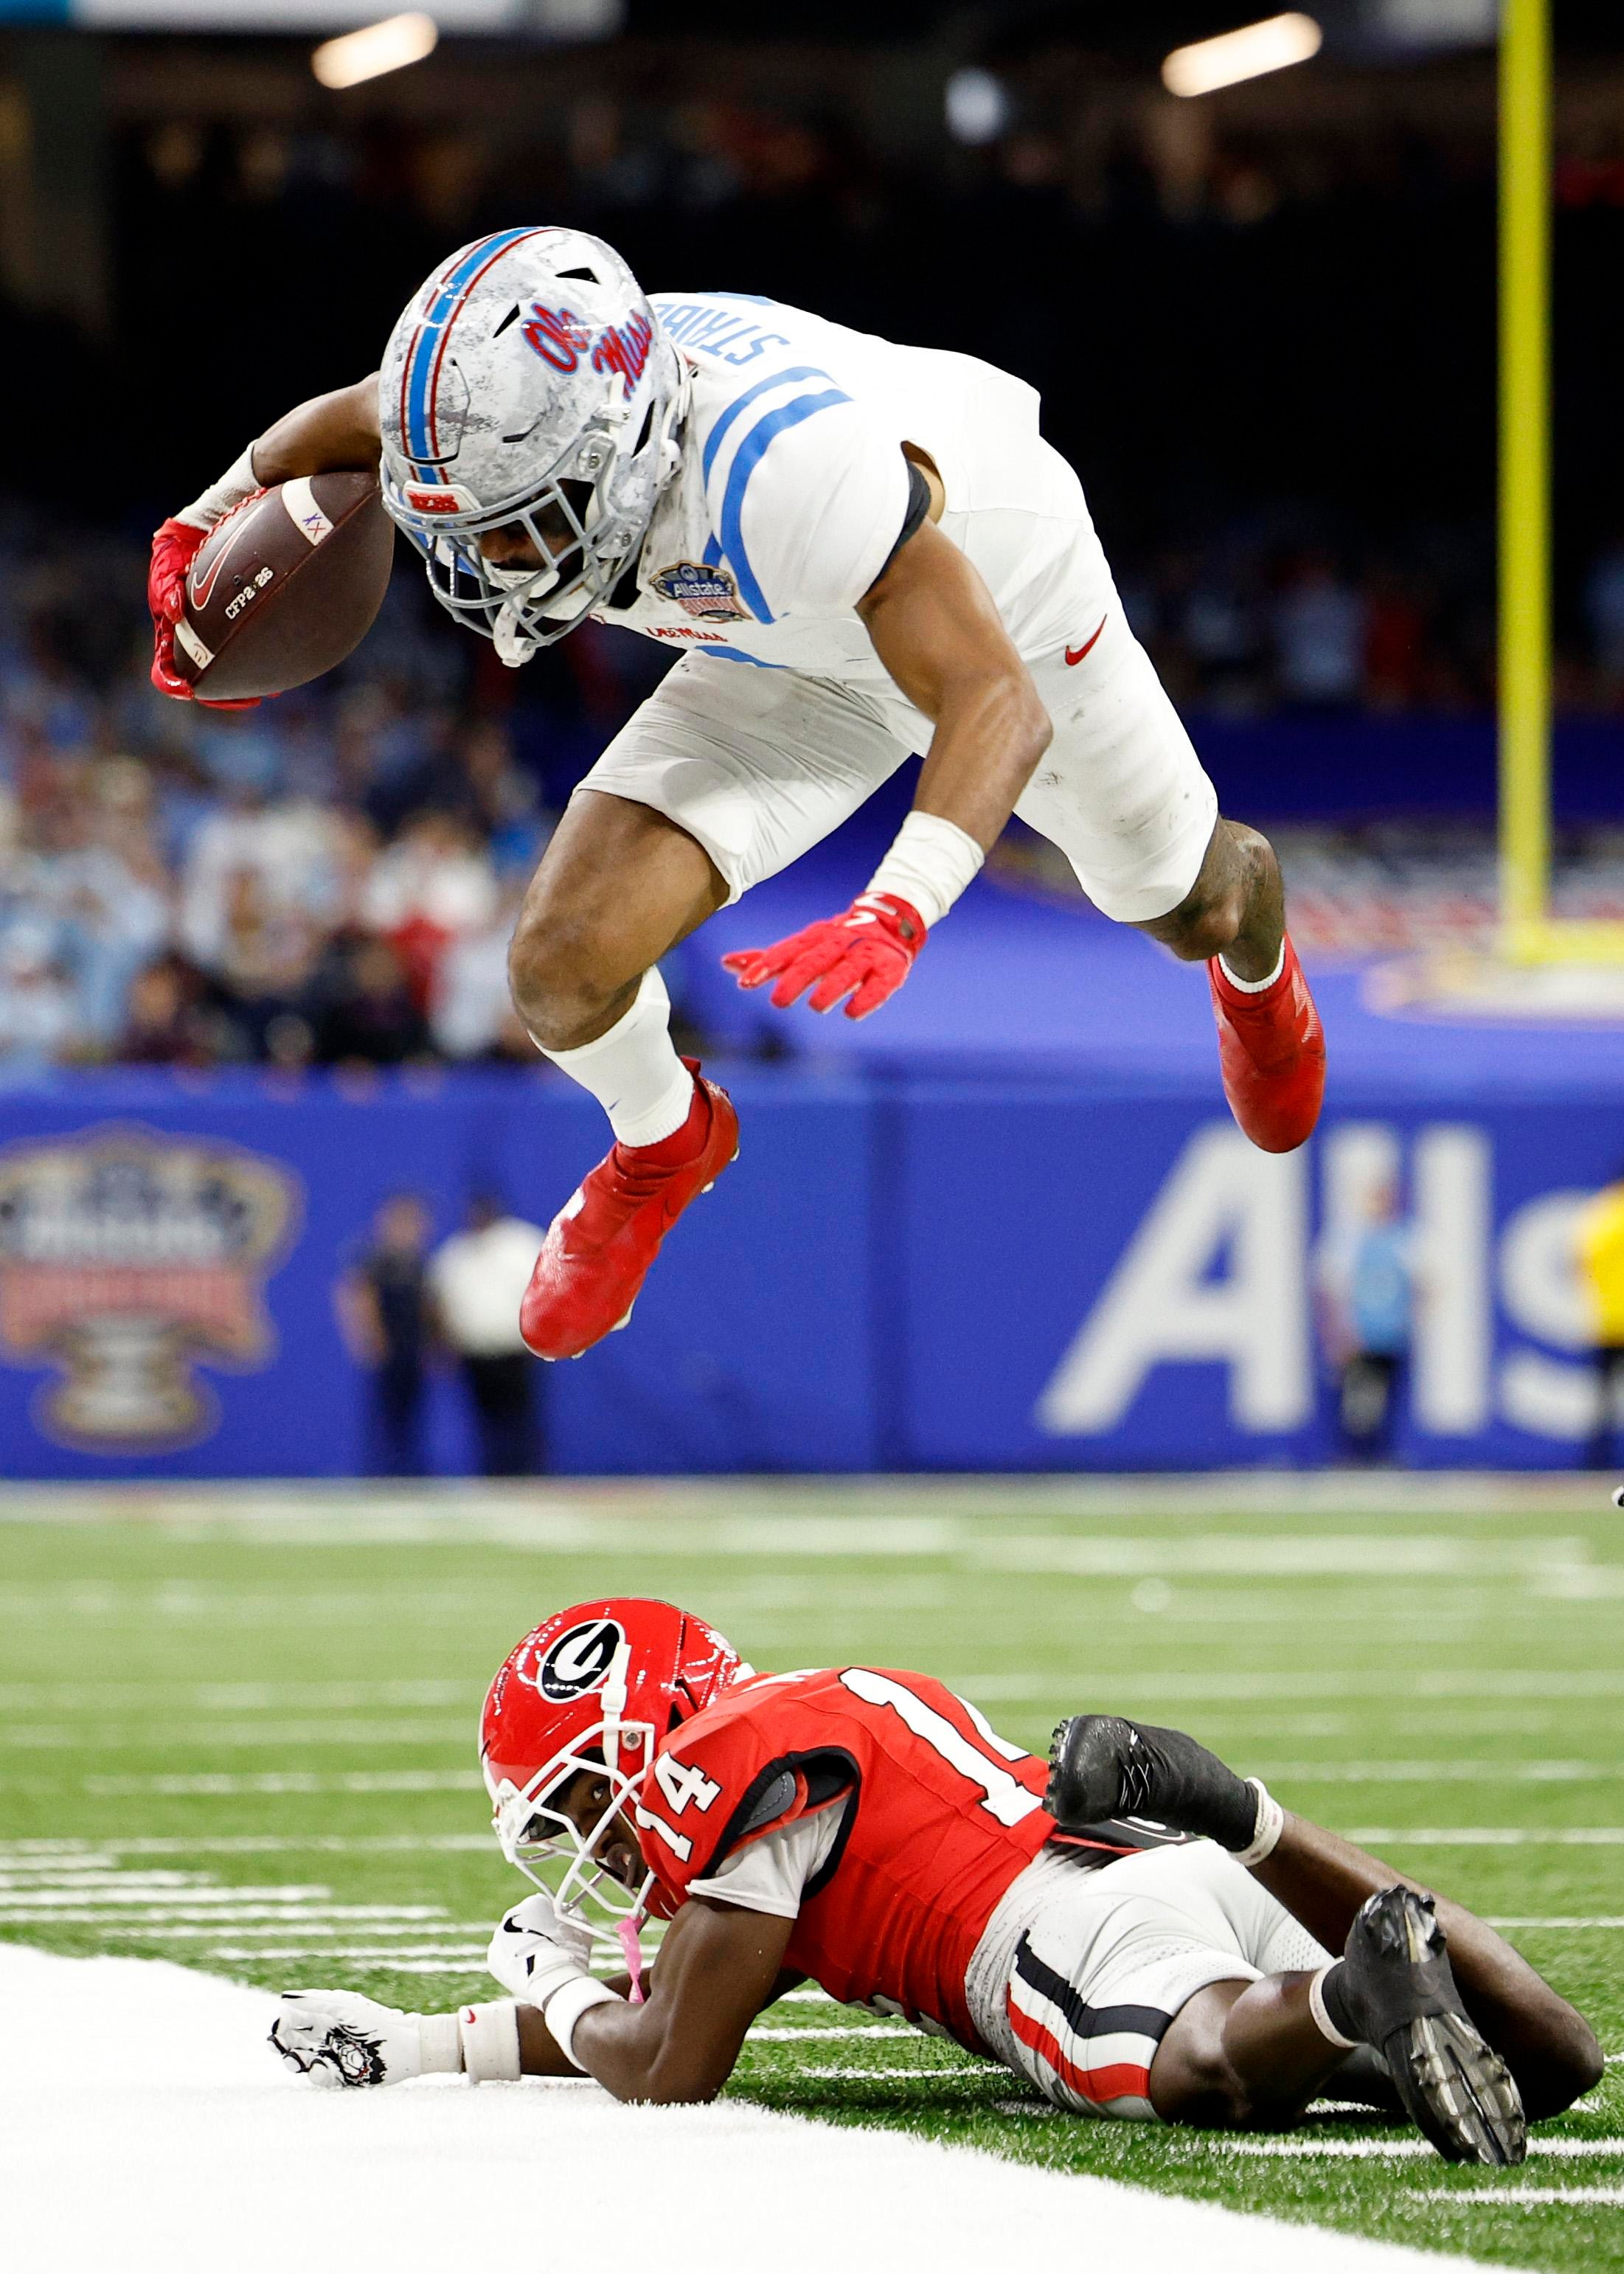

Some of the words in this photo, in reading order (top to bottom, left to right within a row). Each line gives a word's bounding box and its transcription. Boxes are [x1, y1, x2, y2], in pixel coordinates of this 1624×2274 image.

[521, 302, 591, 375] Ole
[591, 309, 653, 402] Miss
[673, 581, 726, 598] Allstate
[541, 1620, 621, 1700] G
[634, 1750, 723, 1865] 14
